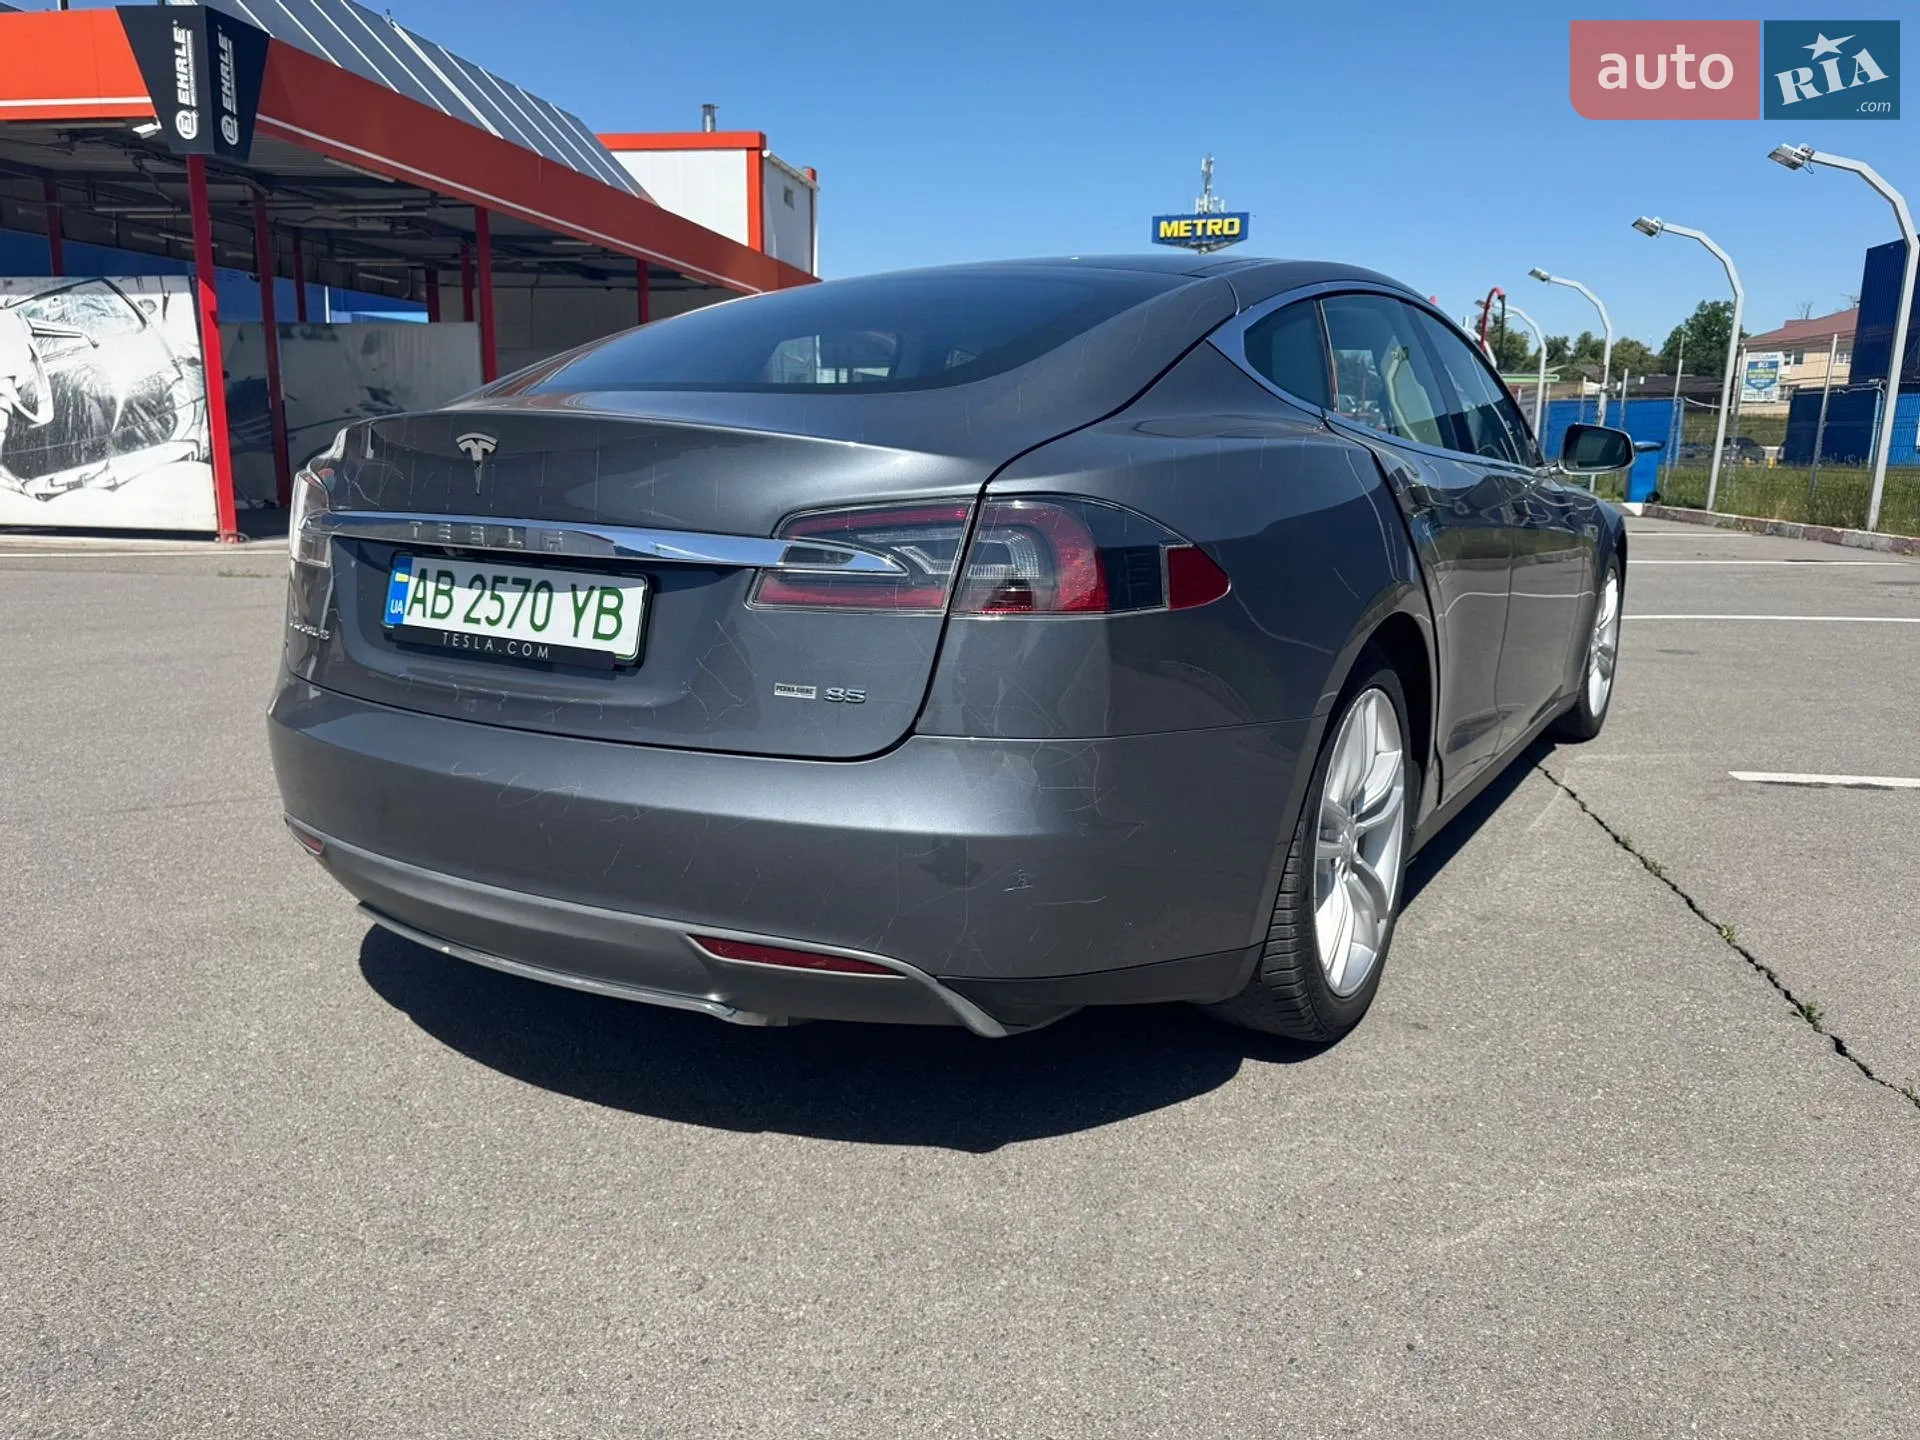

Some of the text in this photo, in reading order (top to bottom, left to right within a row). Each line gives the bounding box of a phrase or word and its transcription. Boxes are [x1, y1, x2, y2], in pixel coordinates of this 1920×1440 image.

[173, 26, 191, 106] EHRLE
[217, 31, 232, 112] EHRLE
[1159, 217, 1240, 238] METRO
[409, 520, 564, 551] TESLA
[390, 600, 404, 615] UA
[406, 567, 624, 641] AB 2570 YB
[442, 631, 549, 661] TESLA.COM
[823, 687, 867, 704] 85
